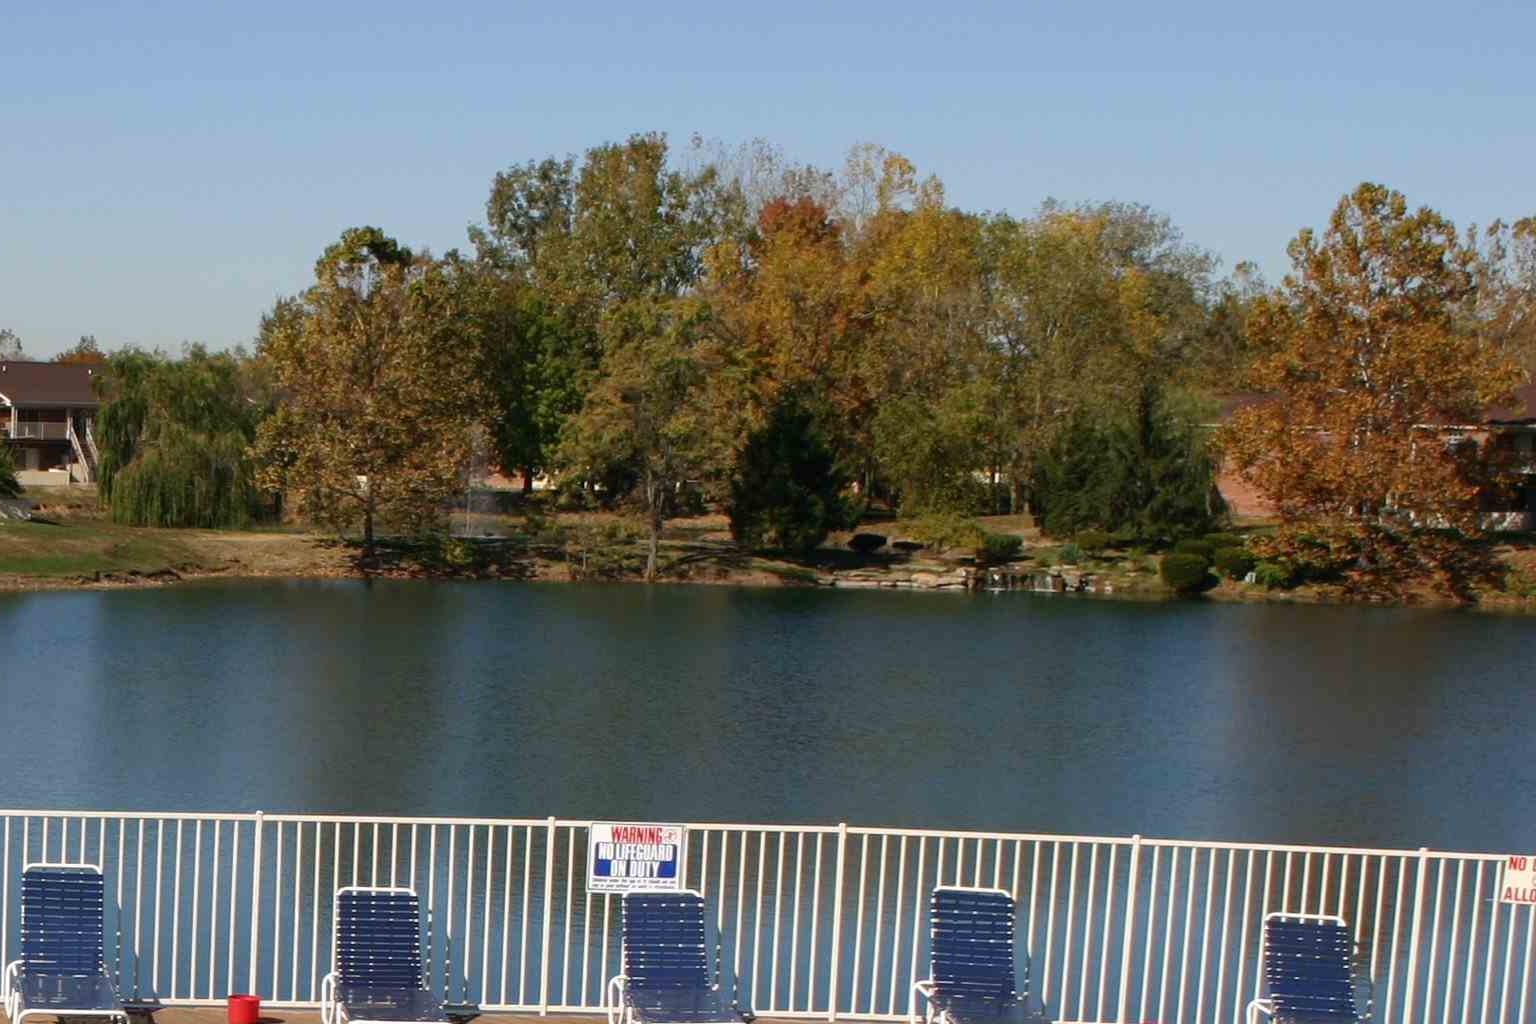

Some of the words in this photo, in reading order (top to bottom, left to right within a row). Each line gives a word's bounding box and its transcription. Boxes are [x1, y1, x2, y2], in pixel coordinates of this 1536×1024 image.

[611, 825, 663, 844] WARNING
[598, 842, 614, 860] NO
[615, 843, 674, 862] LIFEGUARD
[610, 860, 627, 877] ON
[629, 860, 661, 878] DUTY
[1509, 856, 1527, 871] NO
